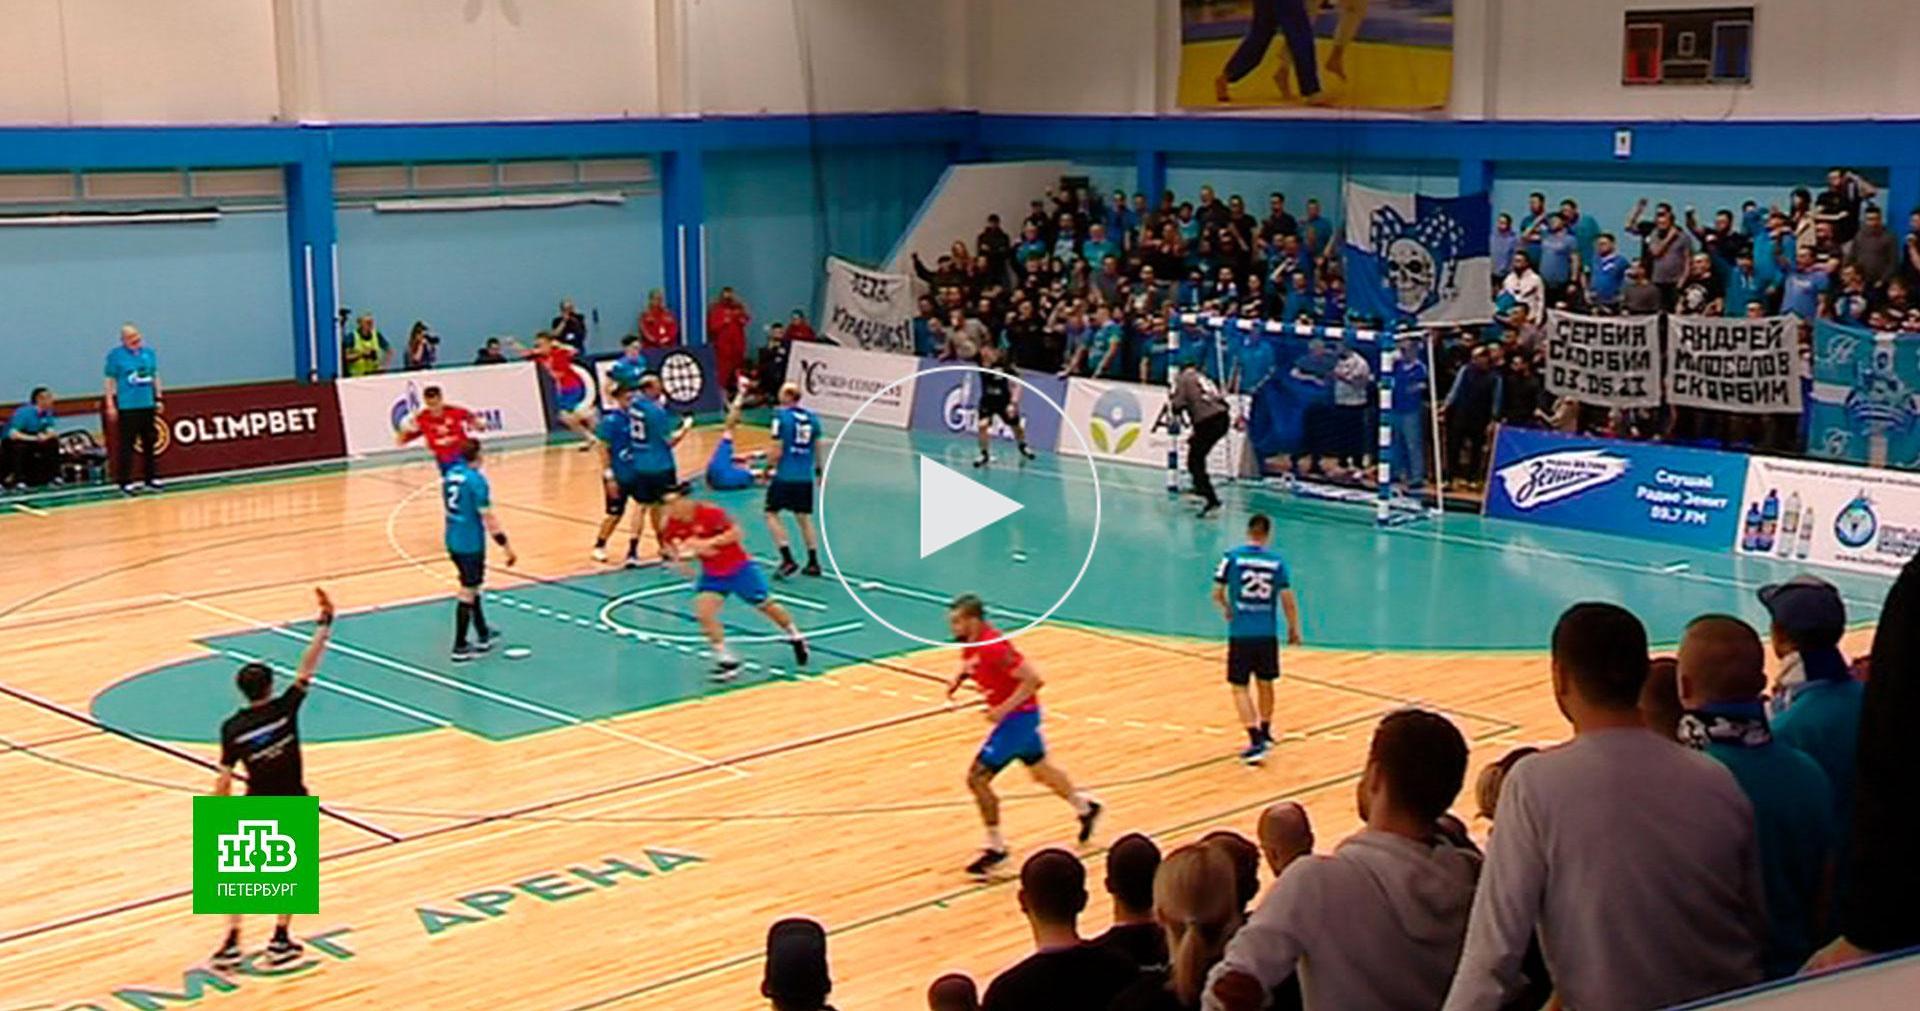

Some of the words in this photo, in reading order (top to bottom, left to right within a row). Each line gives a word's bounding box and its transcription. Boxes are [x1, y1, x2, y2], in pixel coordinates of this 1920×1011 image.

[1556, 320, 1647, 347] СЕРБИЯ
[1680, 320, 1783, 351] АНДРЕЙ
[1673, 373, 1789, 405] СКОРБИМ
[173, 407, 318, 444] OLIMPBET
[415, 849, 706, 935] АРЕНА
